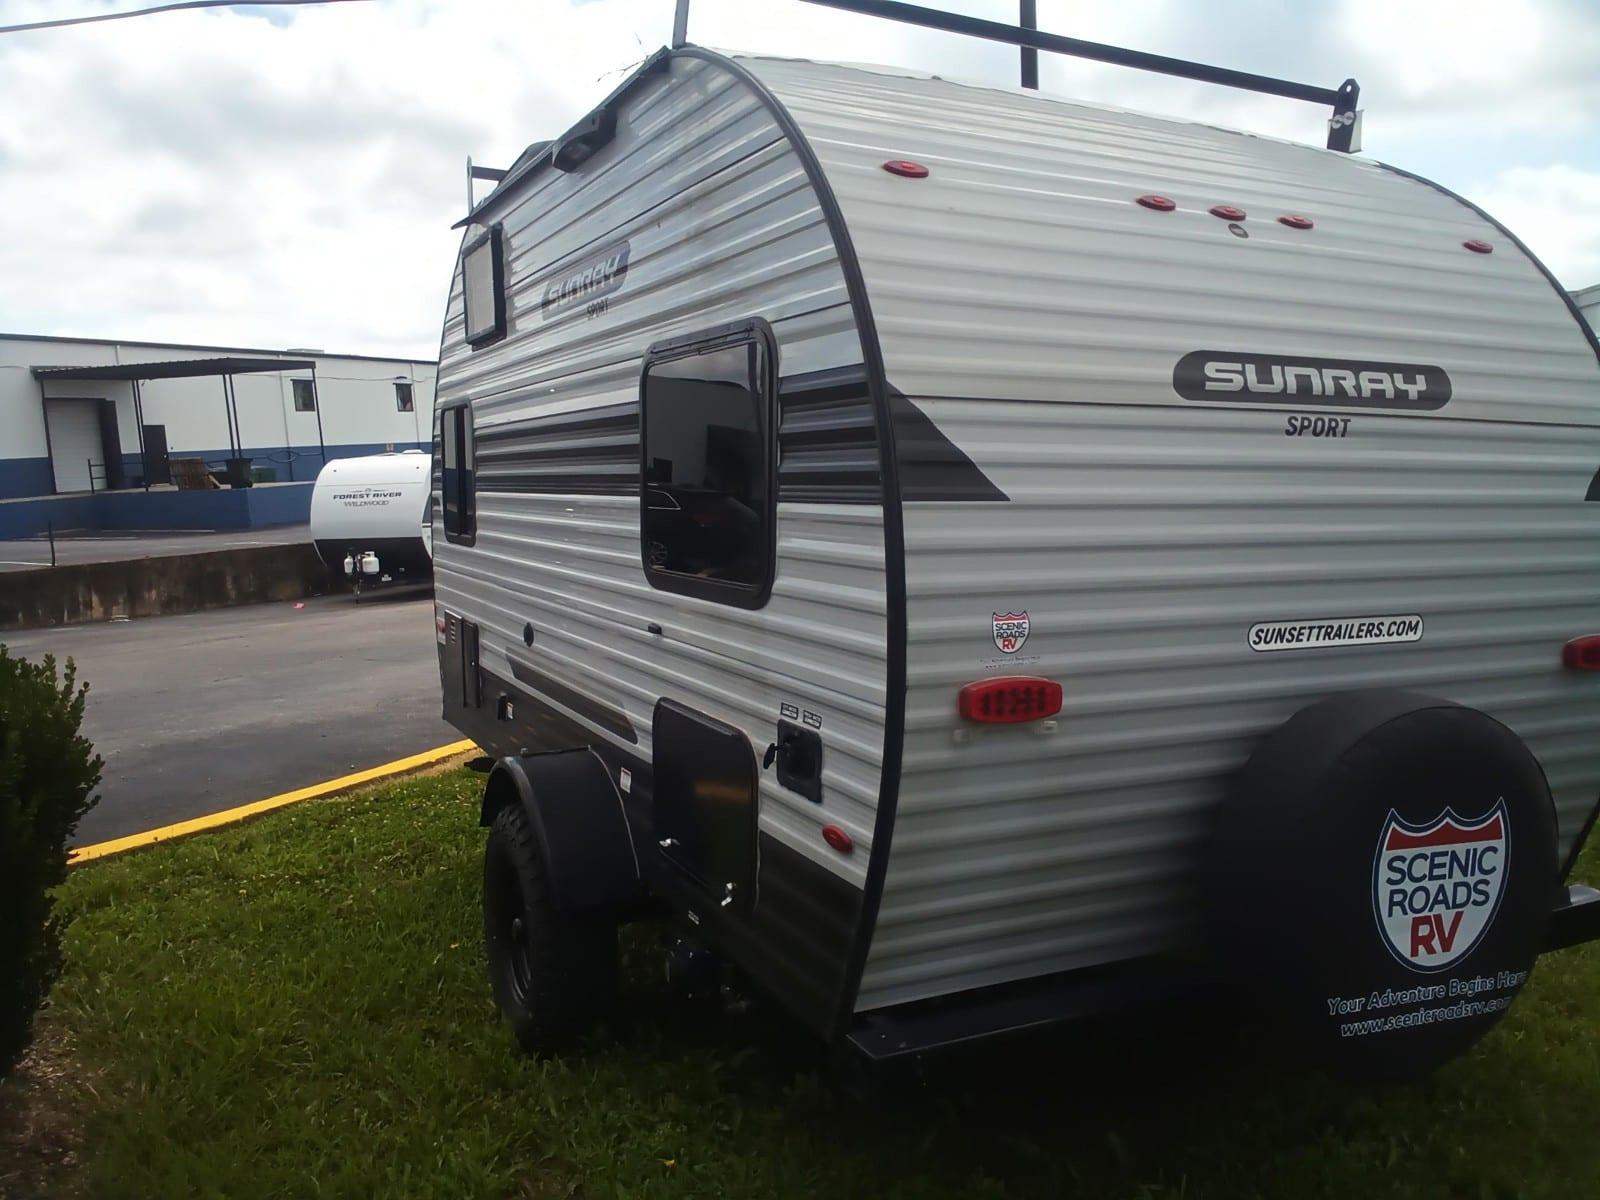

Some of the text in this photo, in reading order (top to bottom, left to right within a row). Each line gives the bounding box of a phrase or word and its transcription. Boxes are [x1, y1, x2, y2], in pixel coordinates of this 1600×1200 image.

[1204, 361, 1427, 400] SUNRAY
[1284, 415, 1352, 438] SPORT
[995, 621, 1027, 632] SCENIC
[996, 630, 1026, 640] ROADS
[1252, 619, 1420, 646] SUNSETTRAILERS.COM
[1002, 639, 1018, 650] RV
[1386, 846, 1499, 886] SCENIC
[1388, 879, 1491, 918] ROADS
[1410, 910, 1465, 958] RV
[1327, 997, 1366, 1016] Your
[1367, 988, 1447, 1010] Adventure
[1449, 974, 1495, 997] Begins
